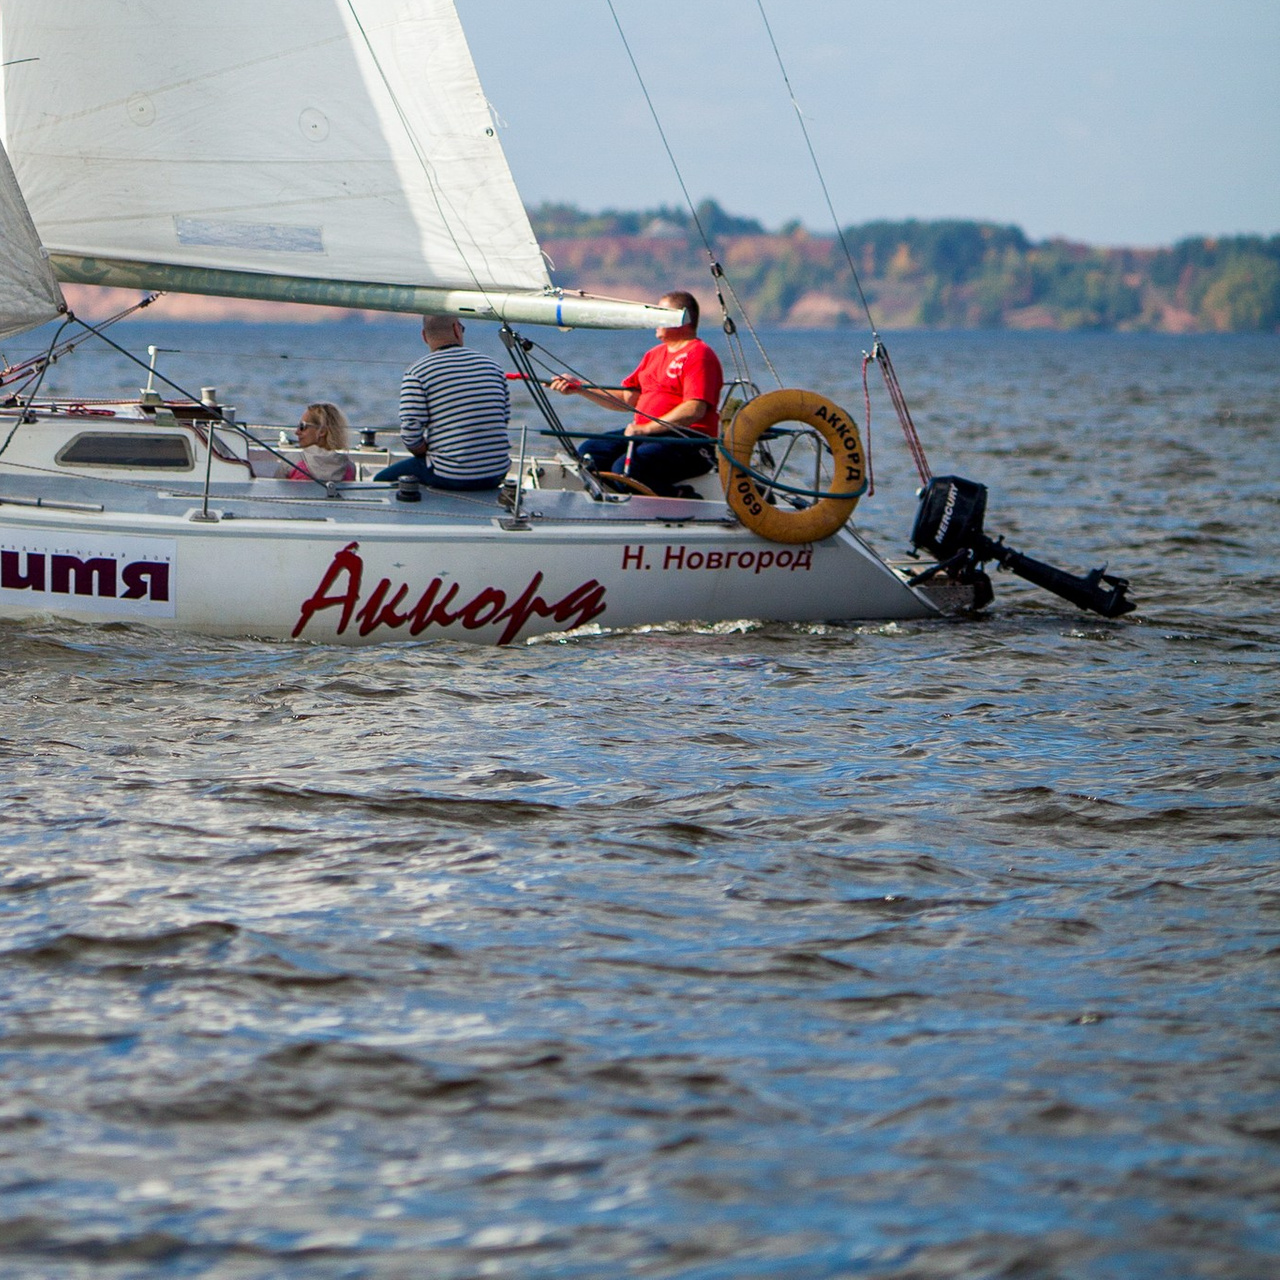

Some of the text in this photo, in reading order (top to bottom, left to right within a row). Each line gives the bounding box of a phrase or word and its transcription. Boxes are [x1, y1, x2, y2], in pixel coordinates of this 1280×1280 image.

[814, 405, 862, 482] АККОРД
[934, 483, 959, 544] MERCURY
[621, 545, 814, 574] Н. Новгород
